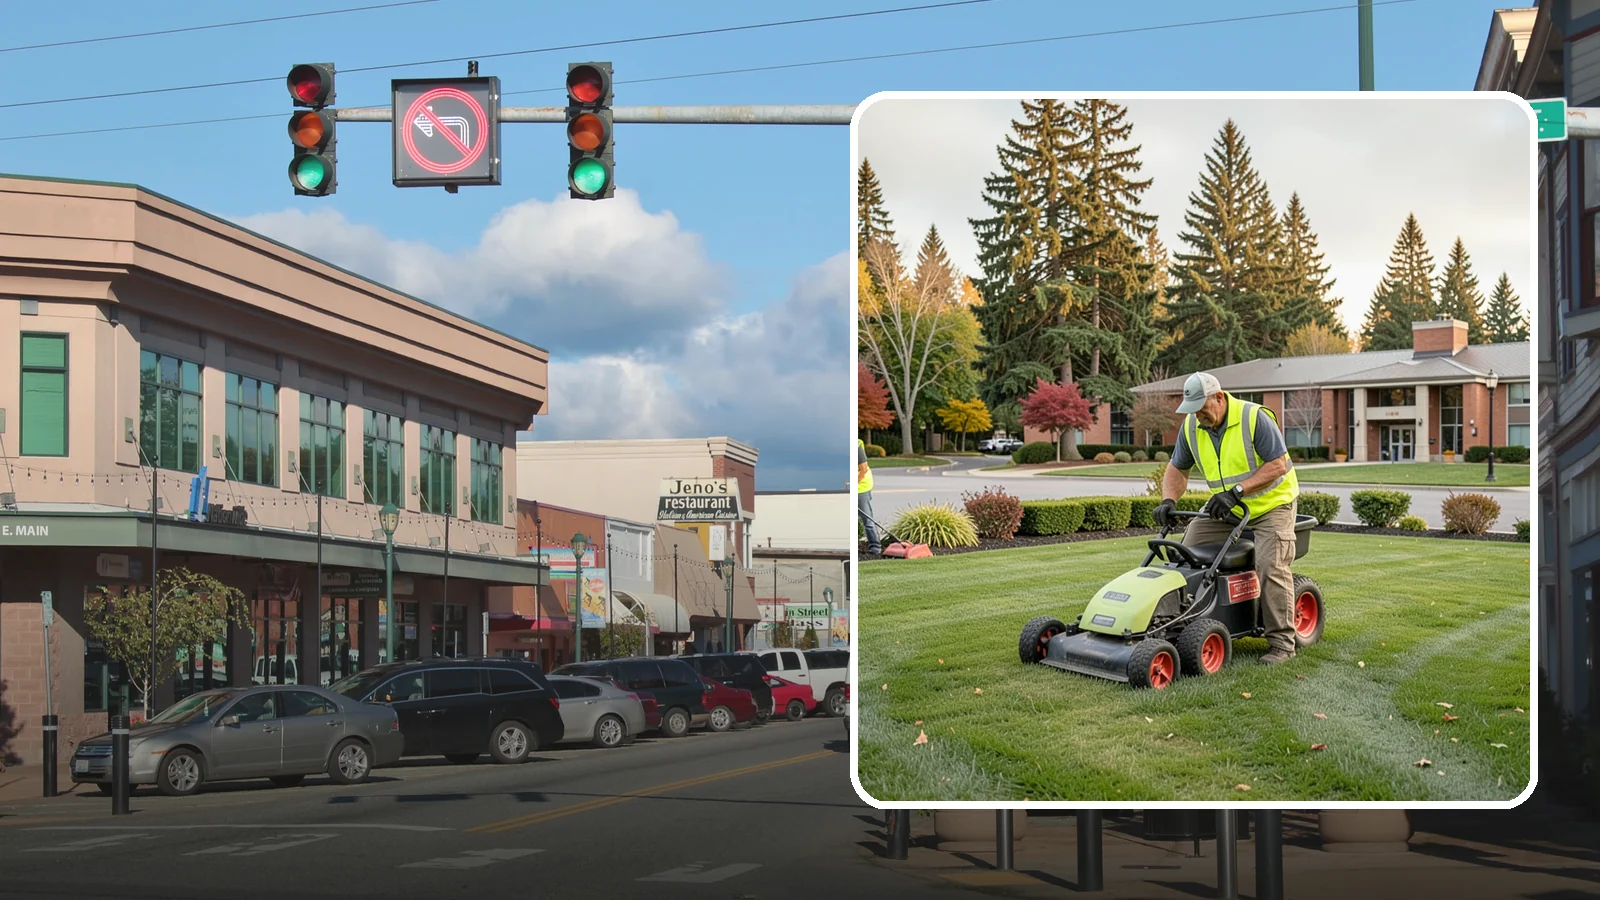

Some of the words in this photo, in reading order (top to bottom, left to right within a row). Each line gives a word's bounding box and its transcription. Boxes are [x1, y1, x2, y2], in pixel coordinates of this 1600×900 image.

[669, 480, 727, 494] Jeno's
[665, 496, 731, 509] restaurant
[658, 509, 682, 520] Italian
[686, 509, 714, 519] American
[714, 509, 737, 519] Cuisine
[2, 525, 13, 536] E.
[15, 525, 49, 536] MAIN
[797, 607, 828, 617] Street
[791, 619, 823, 627] lass
